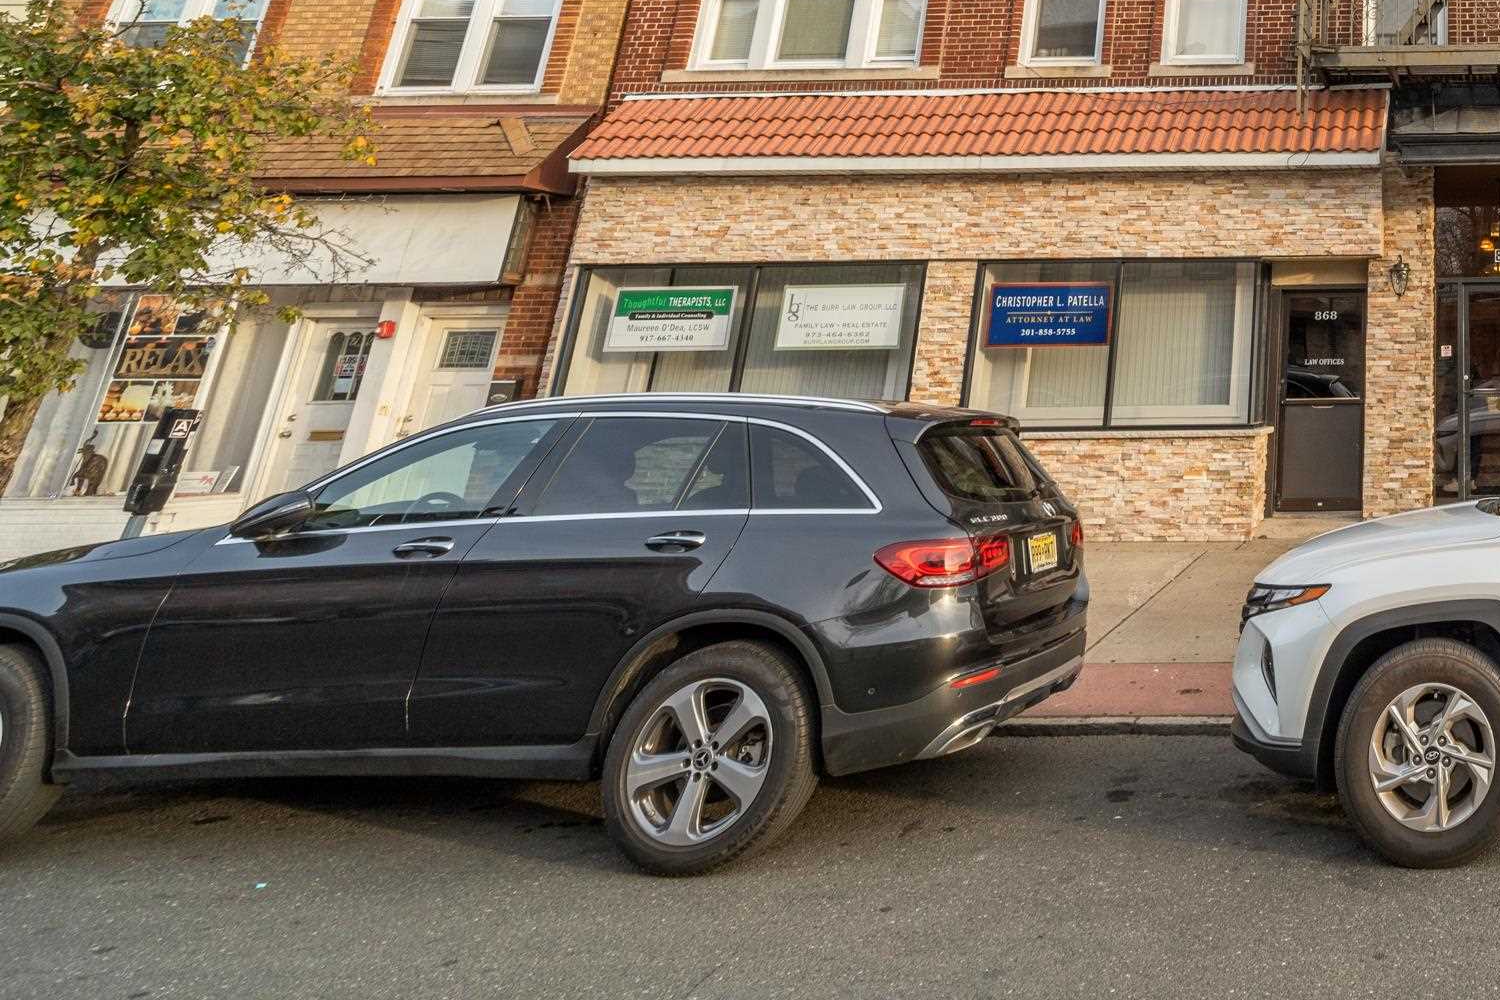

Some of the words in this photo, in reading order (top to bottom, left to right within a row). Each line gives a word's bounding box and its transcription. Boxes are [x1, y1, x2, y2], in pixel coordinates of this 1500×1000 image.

[668, 296, 713, 308] THERAPISTS,
[714, 298, 727, 307] LLC
[996, 295, 1054, 307] CHRISTOPHER
[1056, 295, 1065, 307] L.
[1067, 295, 1105, 307] PATELLA
[842, 303, 857, 311] LAW
[681, 312, 707, 320] Counseling
[1006, 315, 1056, 324] ATTORNEY
[1058, 315, 1070, 323] AT
[1072, 315, 1094, 323] LAW
[1314, 310, 1338, 321] 868
[626, 323, 660, 332] Maureen
[842, 321, 861, 329] REAL
[862, 321, 888, 329] ESTATE
[1020, 328, 1076, 336] 201-858-5755
[116, 348, 204, 377] RELAX
[1304, 358, 1318, 366] LAW
[1319, 358, 1345, 366] OFFICES
